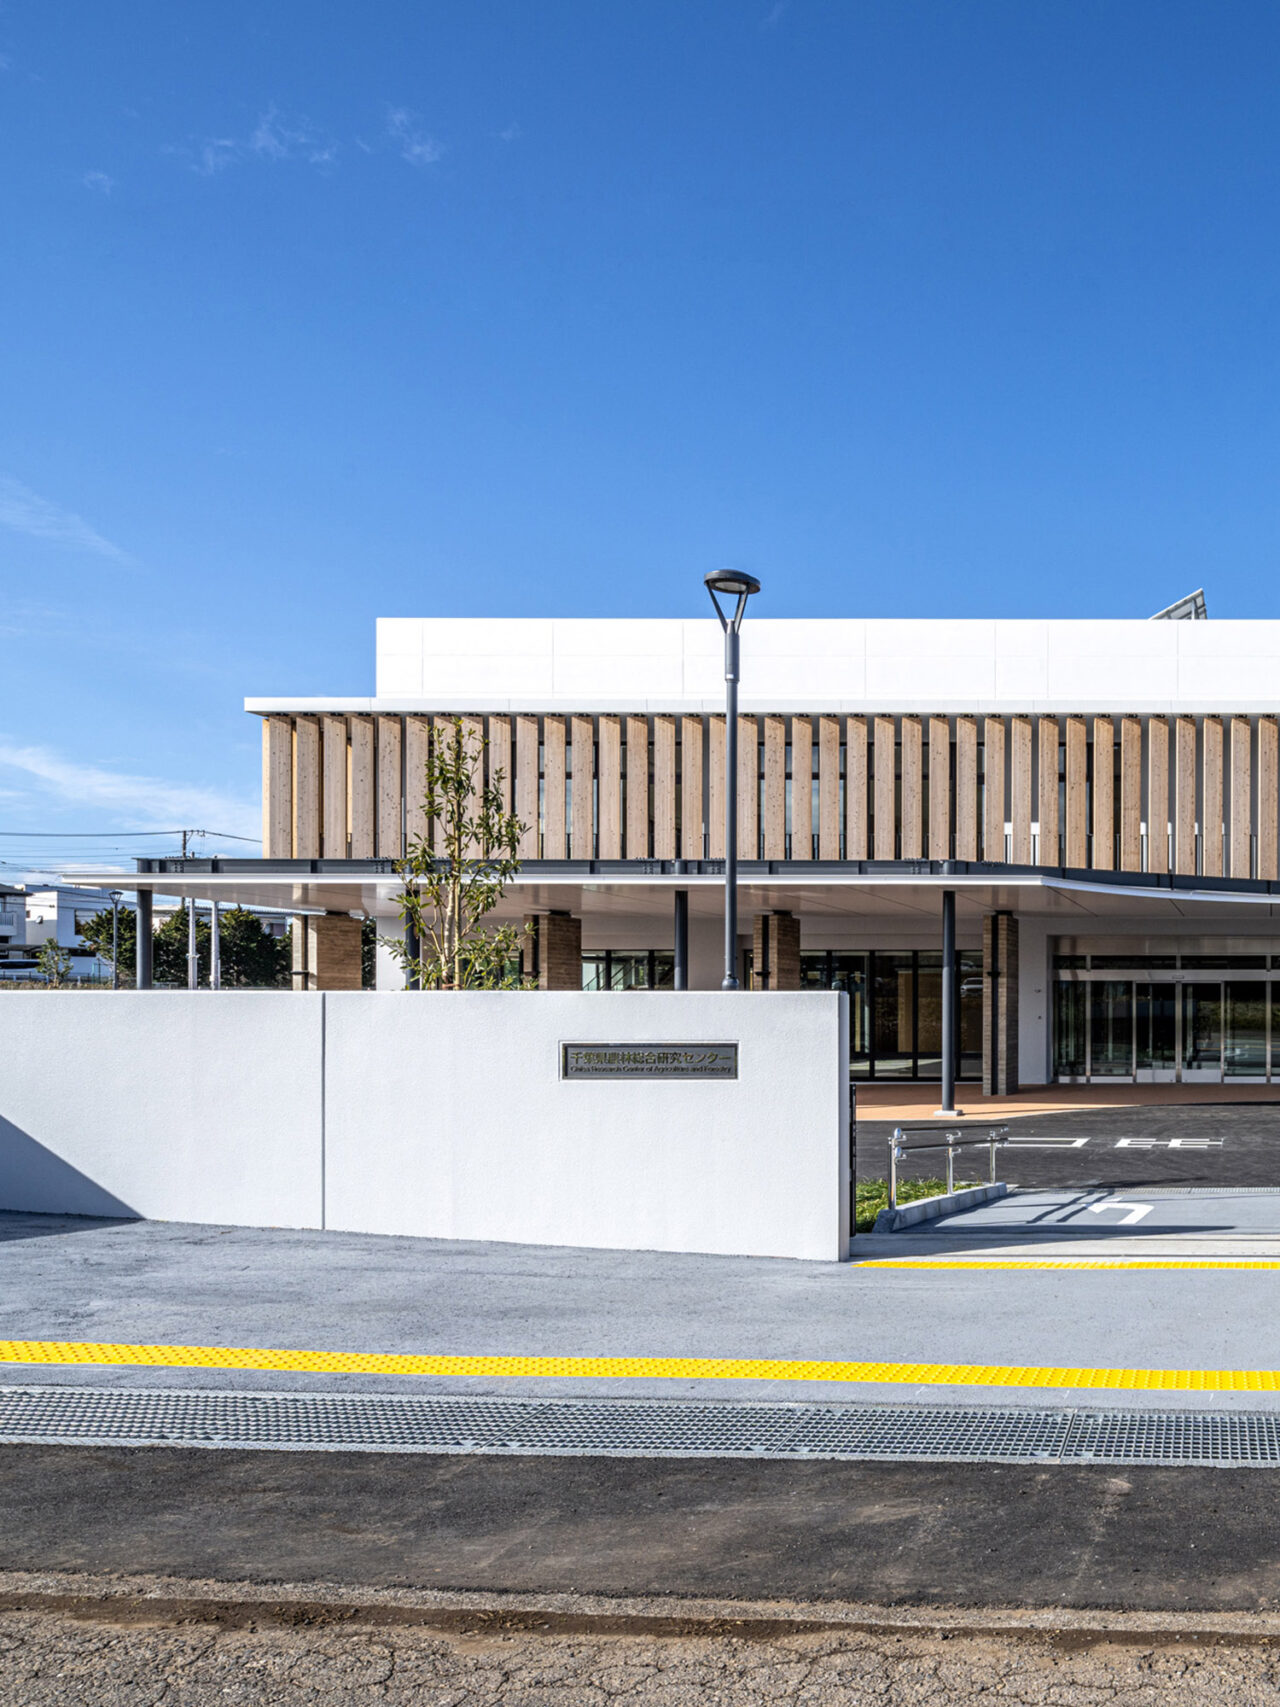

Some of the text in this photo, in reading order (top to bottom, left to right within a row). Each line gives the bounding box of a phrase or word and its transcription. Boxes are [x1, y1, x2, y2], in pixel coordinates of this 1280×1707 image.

[570, 1052, 732, 1064] 千葉県農林総合研究センター
[645, 1065, 653, 1073] of
[690, 1065, 703, 1073] and
